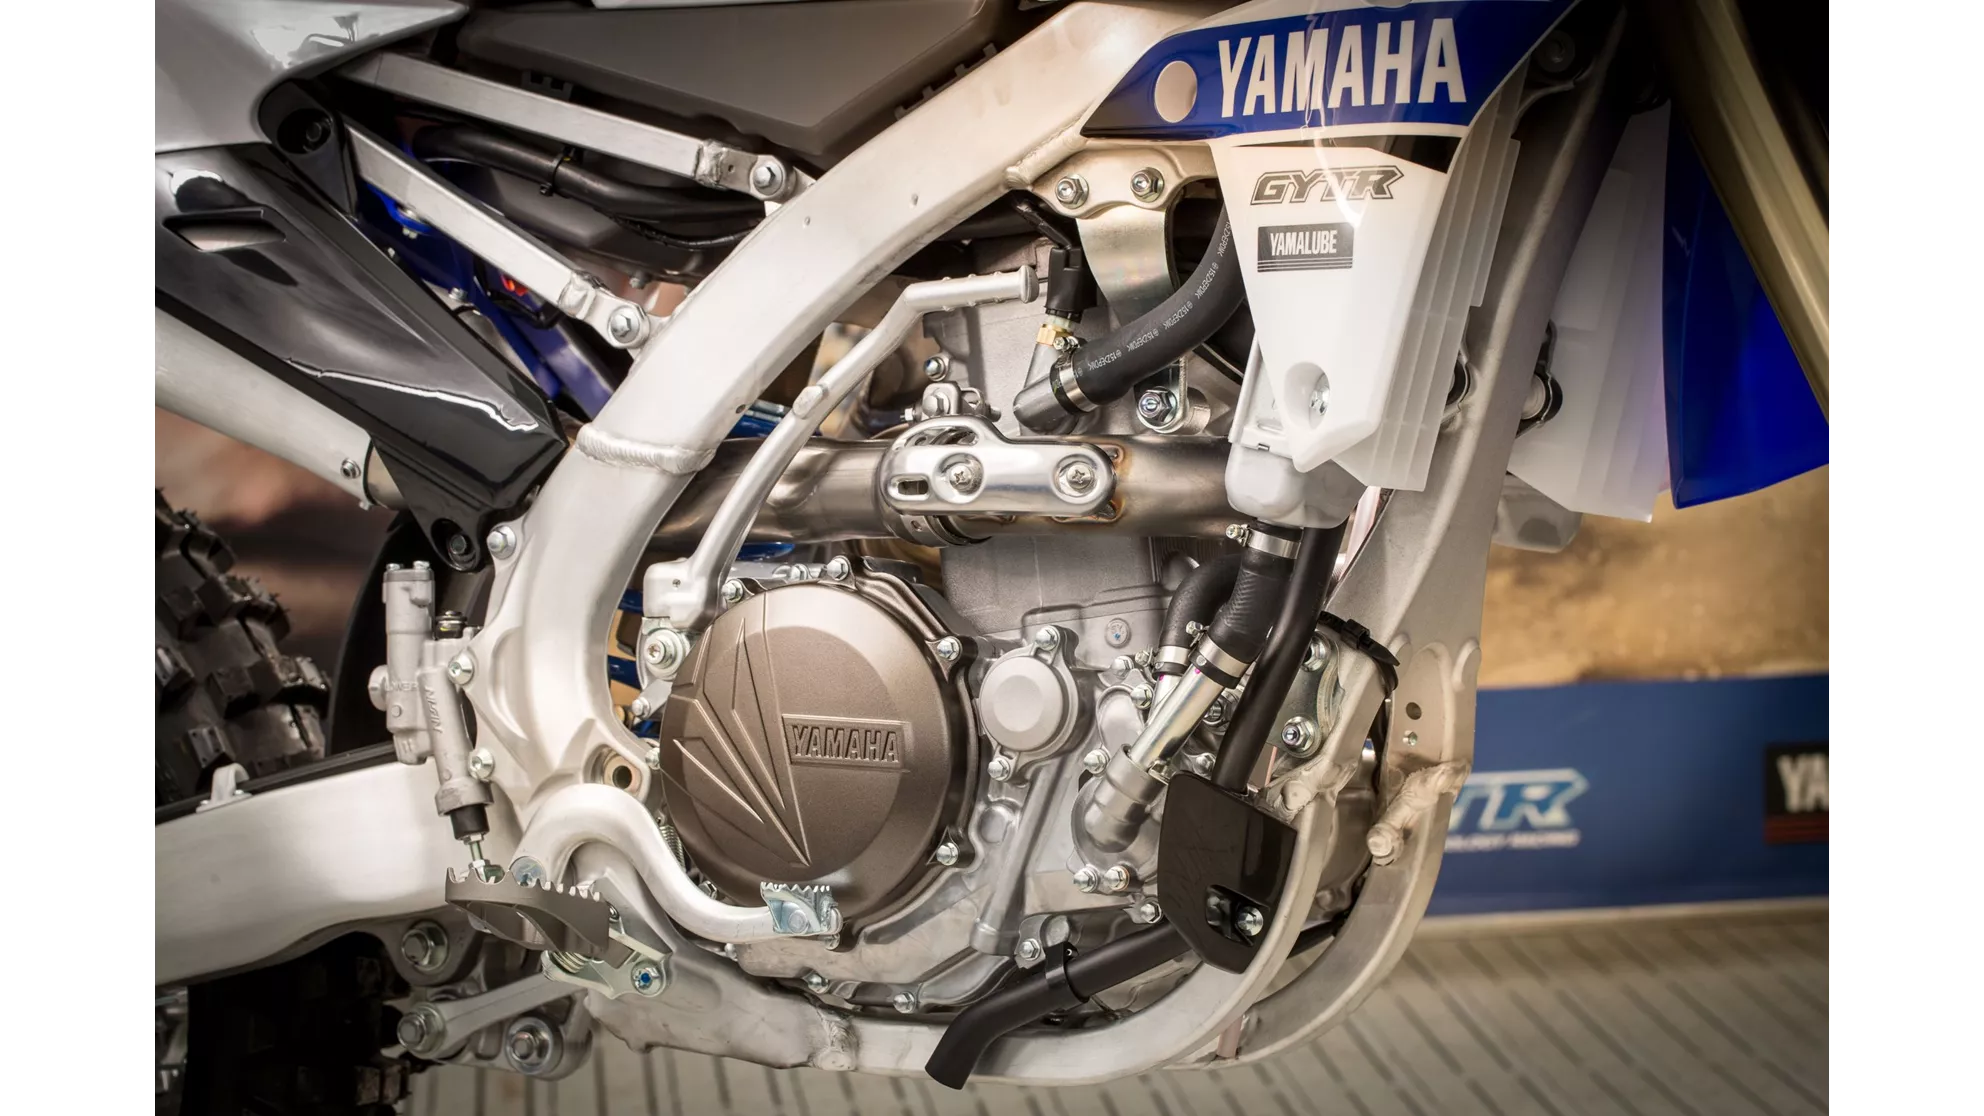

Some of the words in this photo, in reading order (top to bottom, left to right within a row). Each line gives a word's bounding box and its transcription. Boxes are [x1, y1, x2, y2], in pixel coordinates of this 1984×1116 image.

[1218, 18, 1466, 118] YAMAHA
[1250, 165, 1404, 205] GYTR
[1270, 230, 1338, 256] YAMALUBE
[791, 724, 900, 763] YAMAHA
